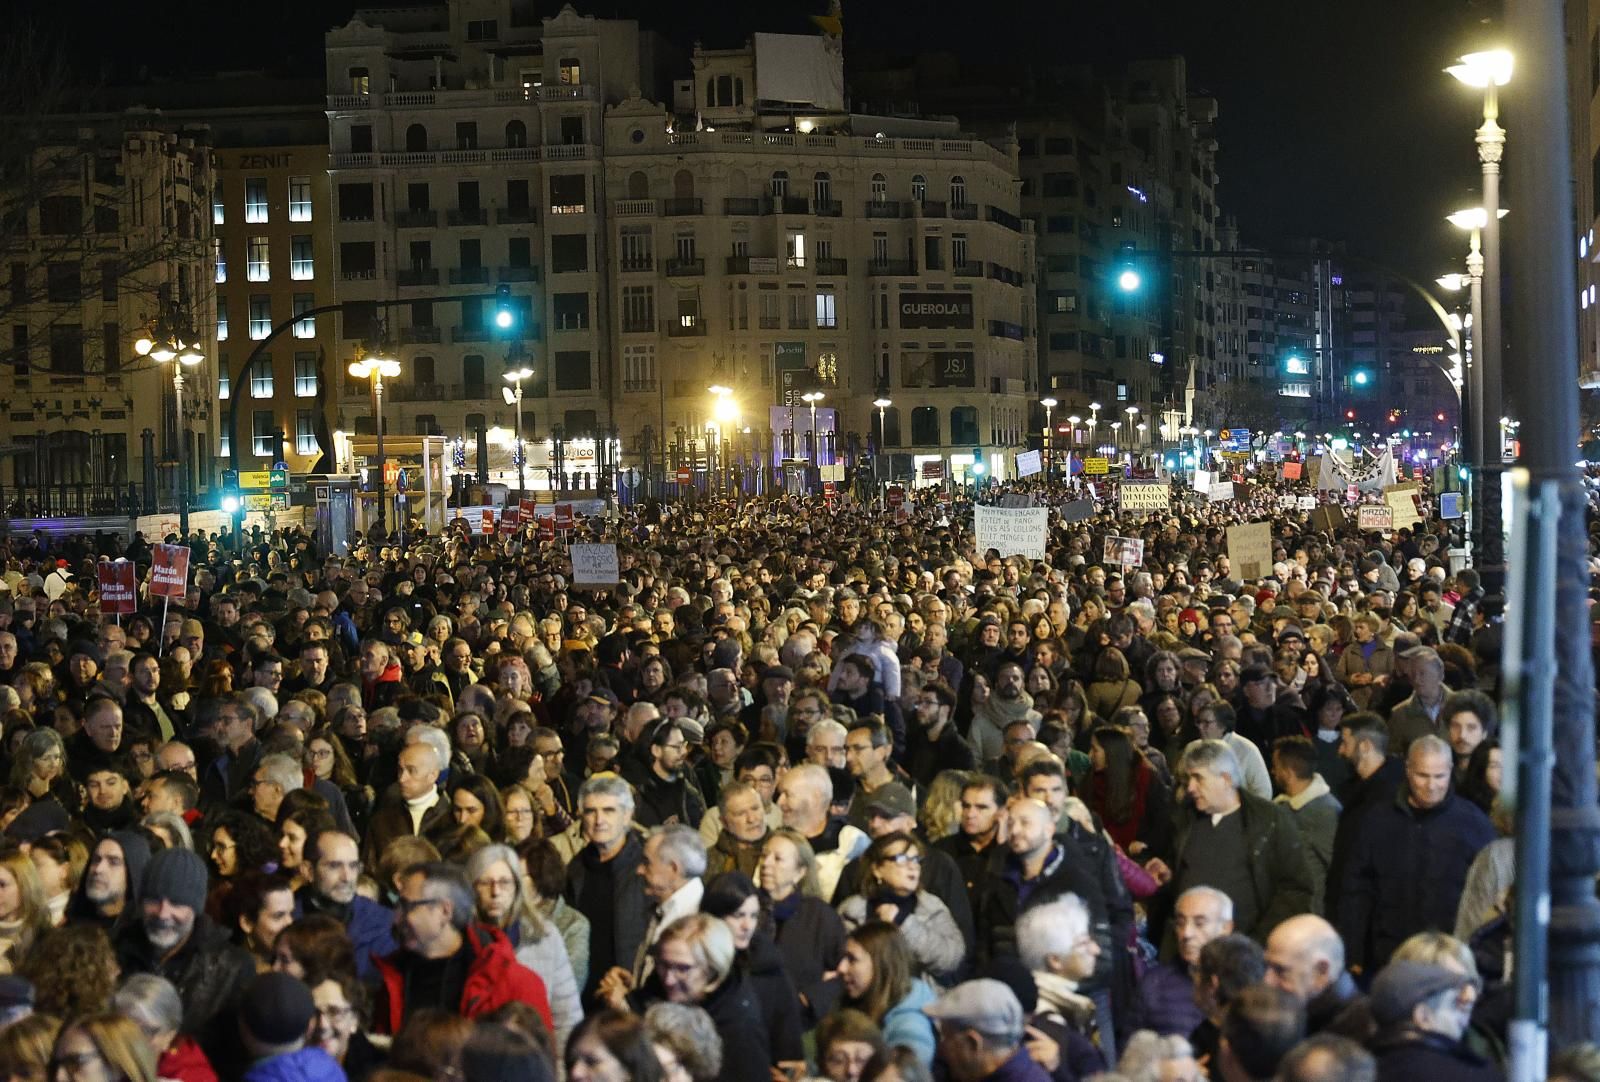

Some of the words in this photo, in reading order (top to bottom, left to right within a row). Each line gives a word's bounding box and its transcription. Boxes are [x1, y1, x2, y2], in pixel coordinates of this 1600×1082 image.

[240, 154, 293, 169] ZENIT
[902, 303, 960, 315] GUEROLA
[943, 358, 967, 373] JSJ
[154, 564, 177, 575] Mazón
[153, 575, 184, 585] dimissió
[101, 582, 125, 591] Mazón
[101, 592, 133, 601] dimissió
